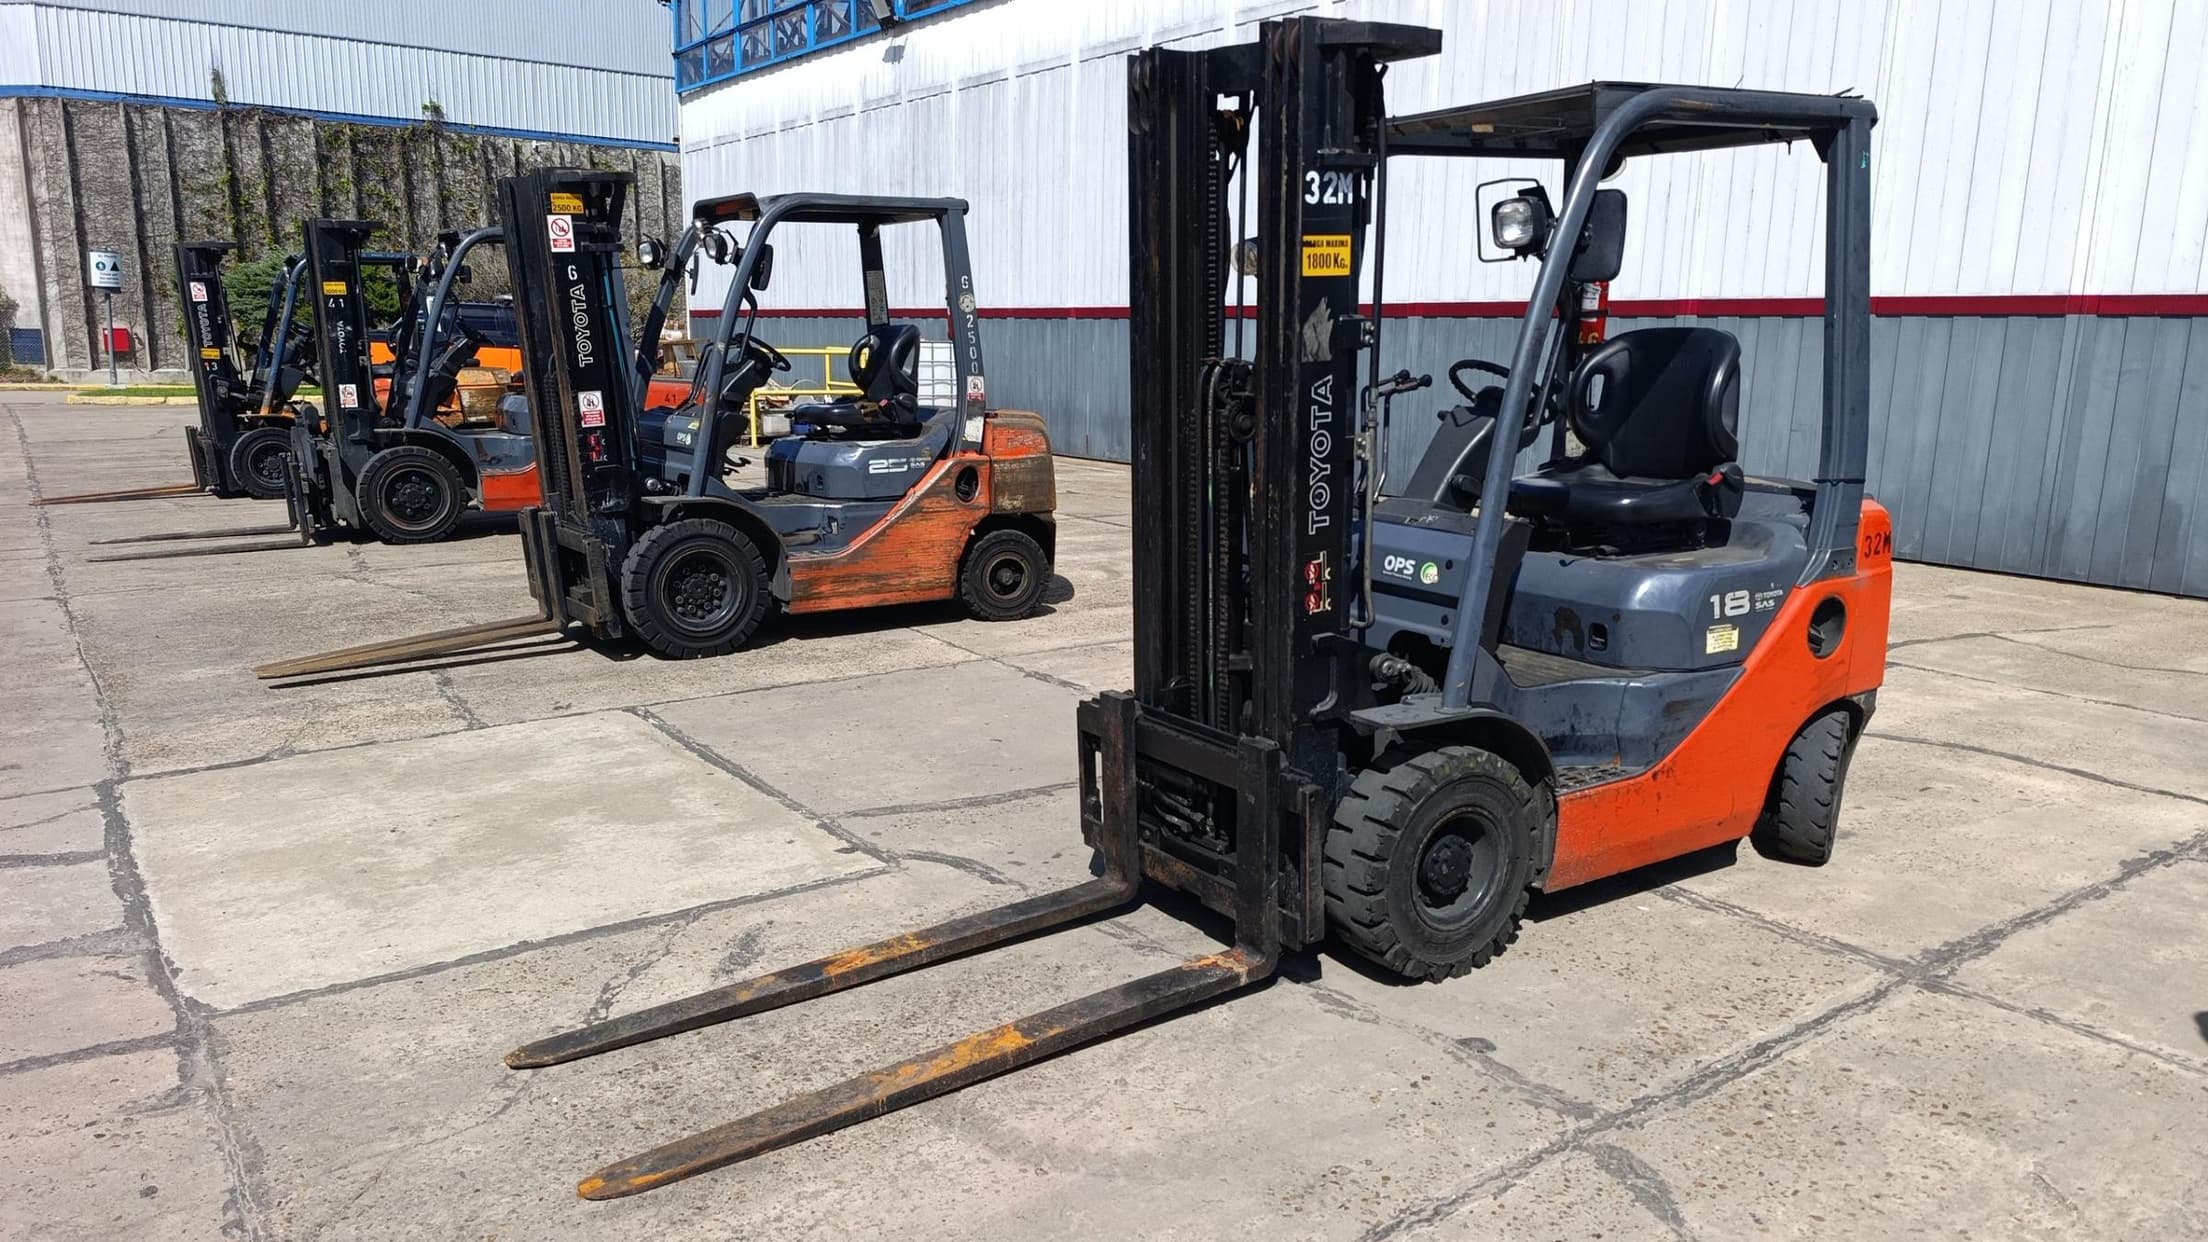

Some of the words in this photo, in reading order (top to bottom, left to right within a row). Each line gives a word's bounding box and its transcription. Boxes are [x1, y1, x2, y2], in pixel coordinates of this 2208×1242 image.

[1304, 170, 1353, 205] 32M
[553, 203, 571, 212] 2500
[572, 204, 583, 212] KG
[1306, 252, 1332, 271] 1800
[328, 297, 345, 308] 41
[197, 303, 213, 347] TOYOTA
[569, 283, 594, 367] TOYOTA
[203, 361, 219, 371] 13
[664, 392, 677, 404] 41
[1308, 374, 1333, 536] TOYOTA
[868, 458, 908, 474] 25
[1864, 530, 1892, 559] 32M
[1384, 554, 1416, 575] OPS
[1709, 589, 1751, 619] 18
[1755, 599, 1776, 610] SAS
